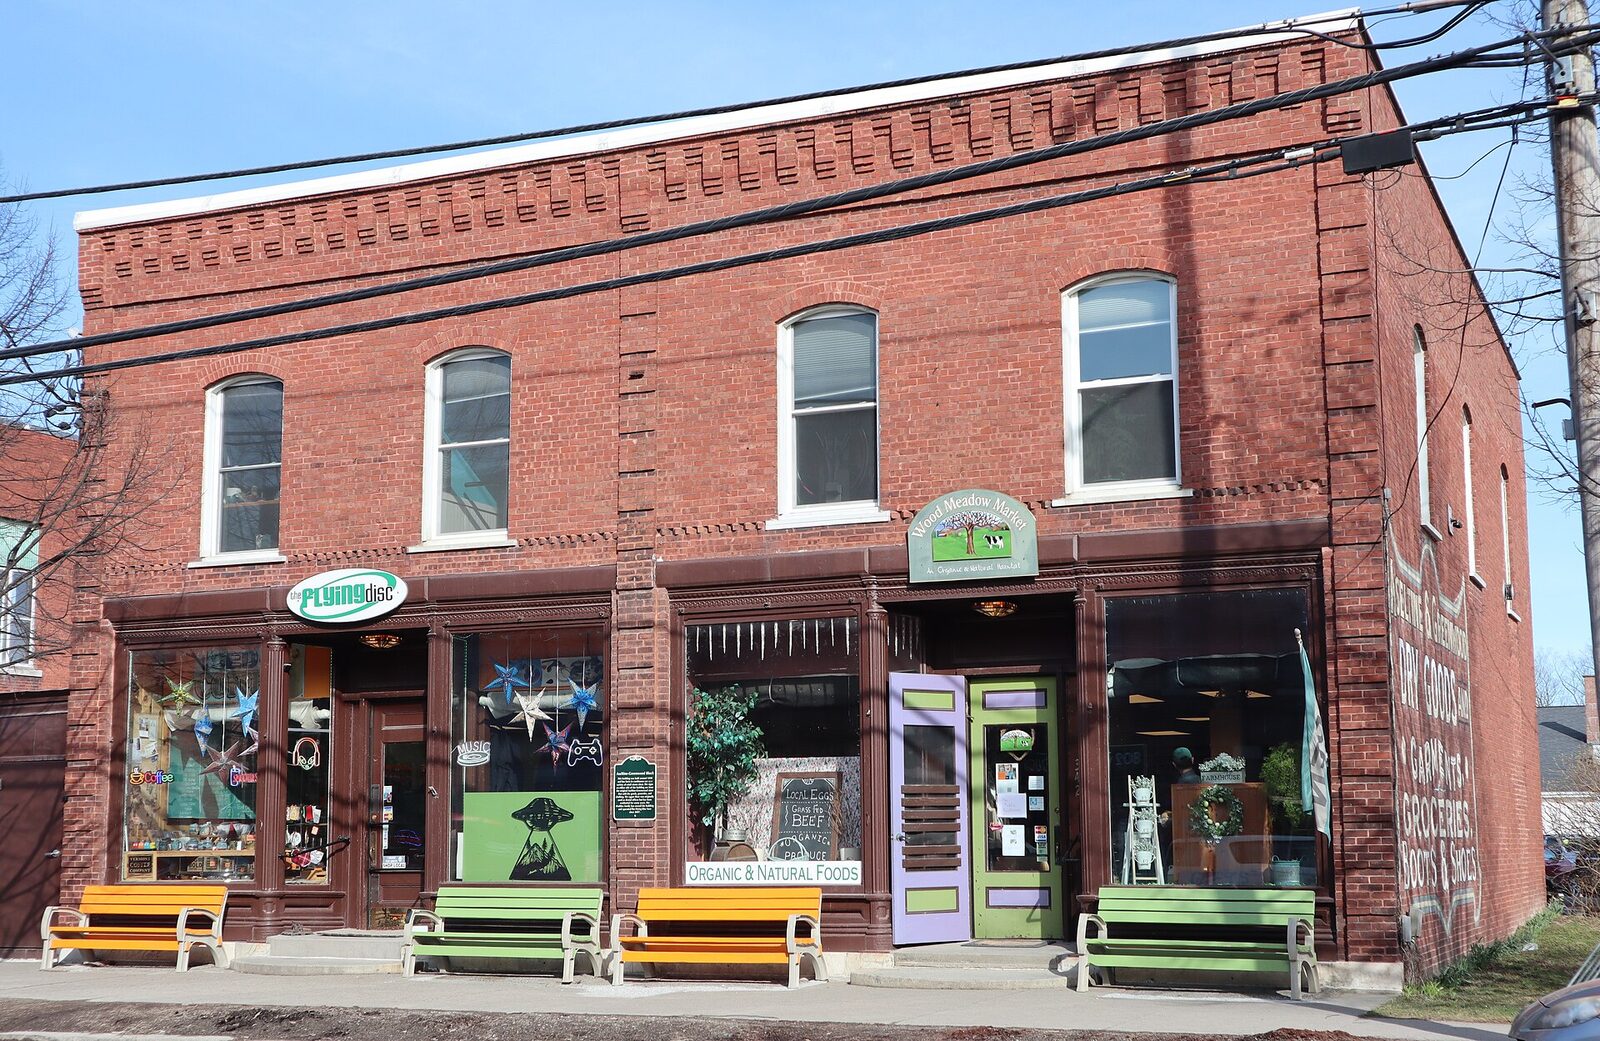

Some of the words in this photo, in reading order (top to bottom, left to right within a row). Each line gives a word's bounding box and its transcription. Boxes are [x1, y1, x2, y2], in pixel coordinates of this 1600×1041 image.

[911, 505, 943, 538] Wood
[944, 493, 991, 513] Meadow
[993, 498, 1028, 531] Market
[938, 565, 962, 576] Organic
[290, 591, 301, 600] the
[365, 583, 393, 602] disc
[1399, 637, 1419, 711] DRY
[1424, 655, 1458, 727] GOODS
[457, 740, 491, 754] MUSIC
[144, 770, 174, 785] Coffee
[786, 788, 809, 800] LOCAL
[810, 788, 834, 801] EGGS
[791, 804, 811, 814] GRASS
[792, 813, 825, 828] BEEF
[689, 864, 742, 881] ORGANIC
[745, 864, 754, 881] &
[757, 864, 813, 881] NATURAL
[816, 864, 859, 881] FOODS
[1401, 840, 1437, 890] BOOTS
[1440, 840, 1449, 890] &
[1451, 840, 1477, 885] SHOES
